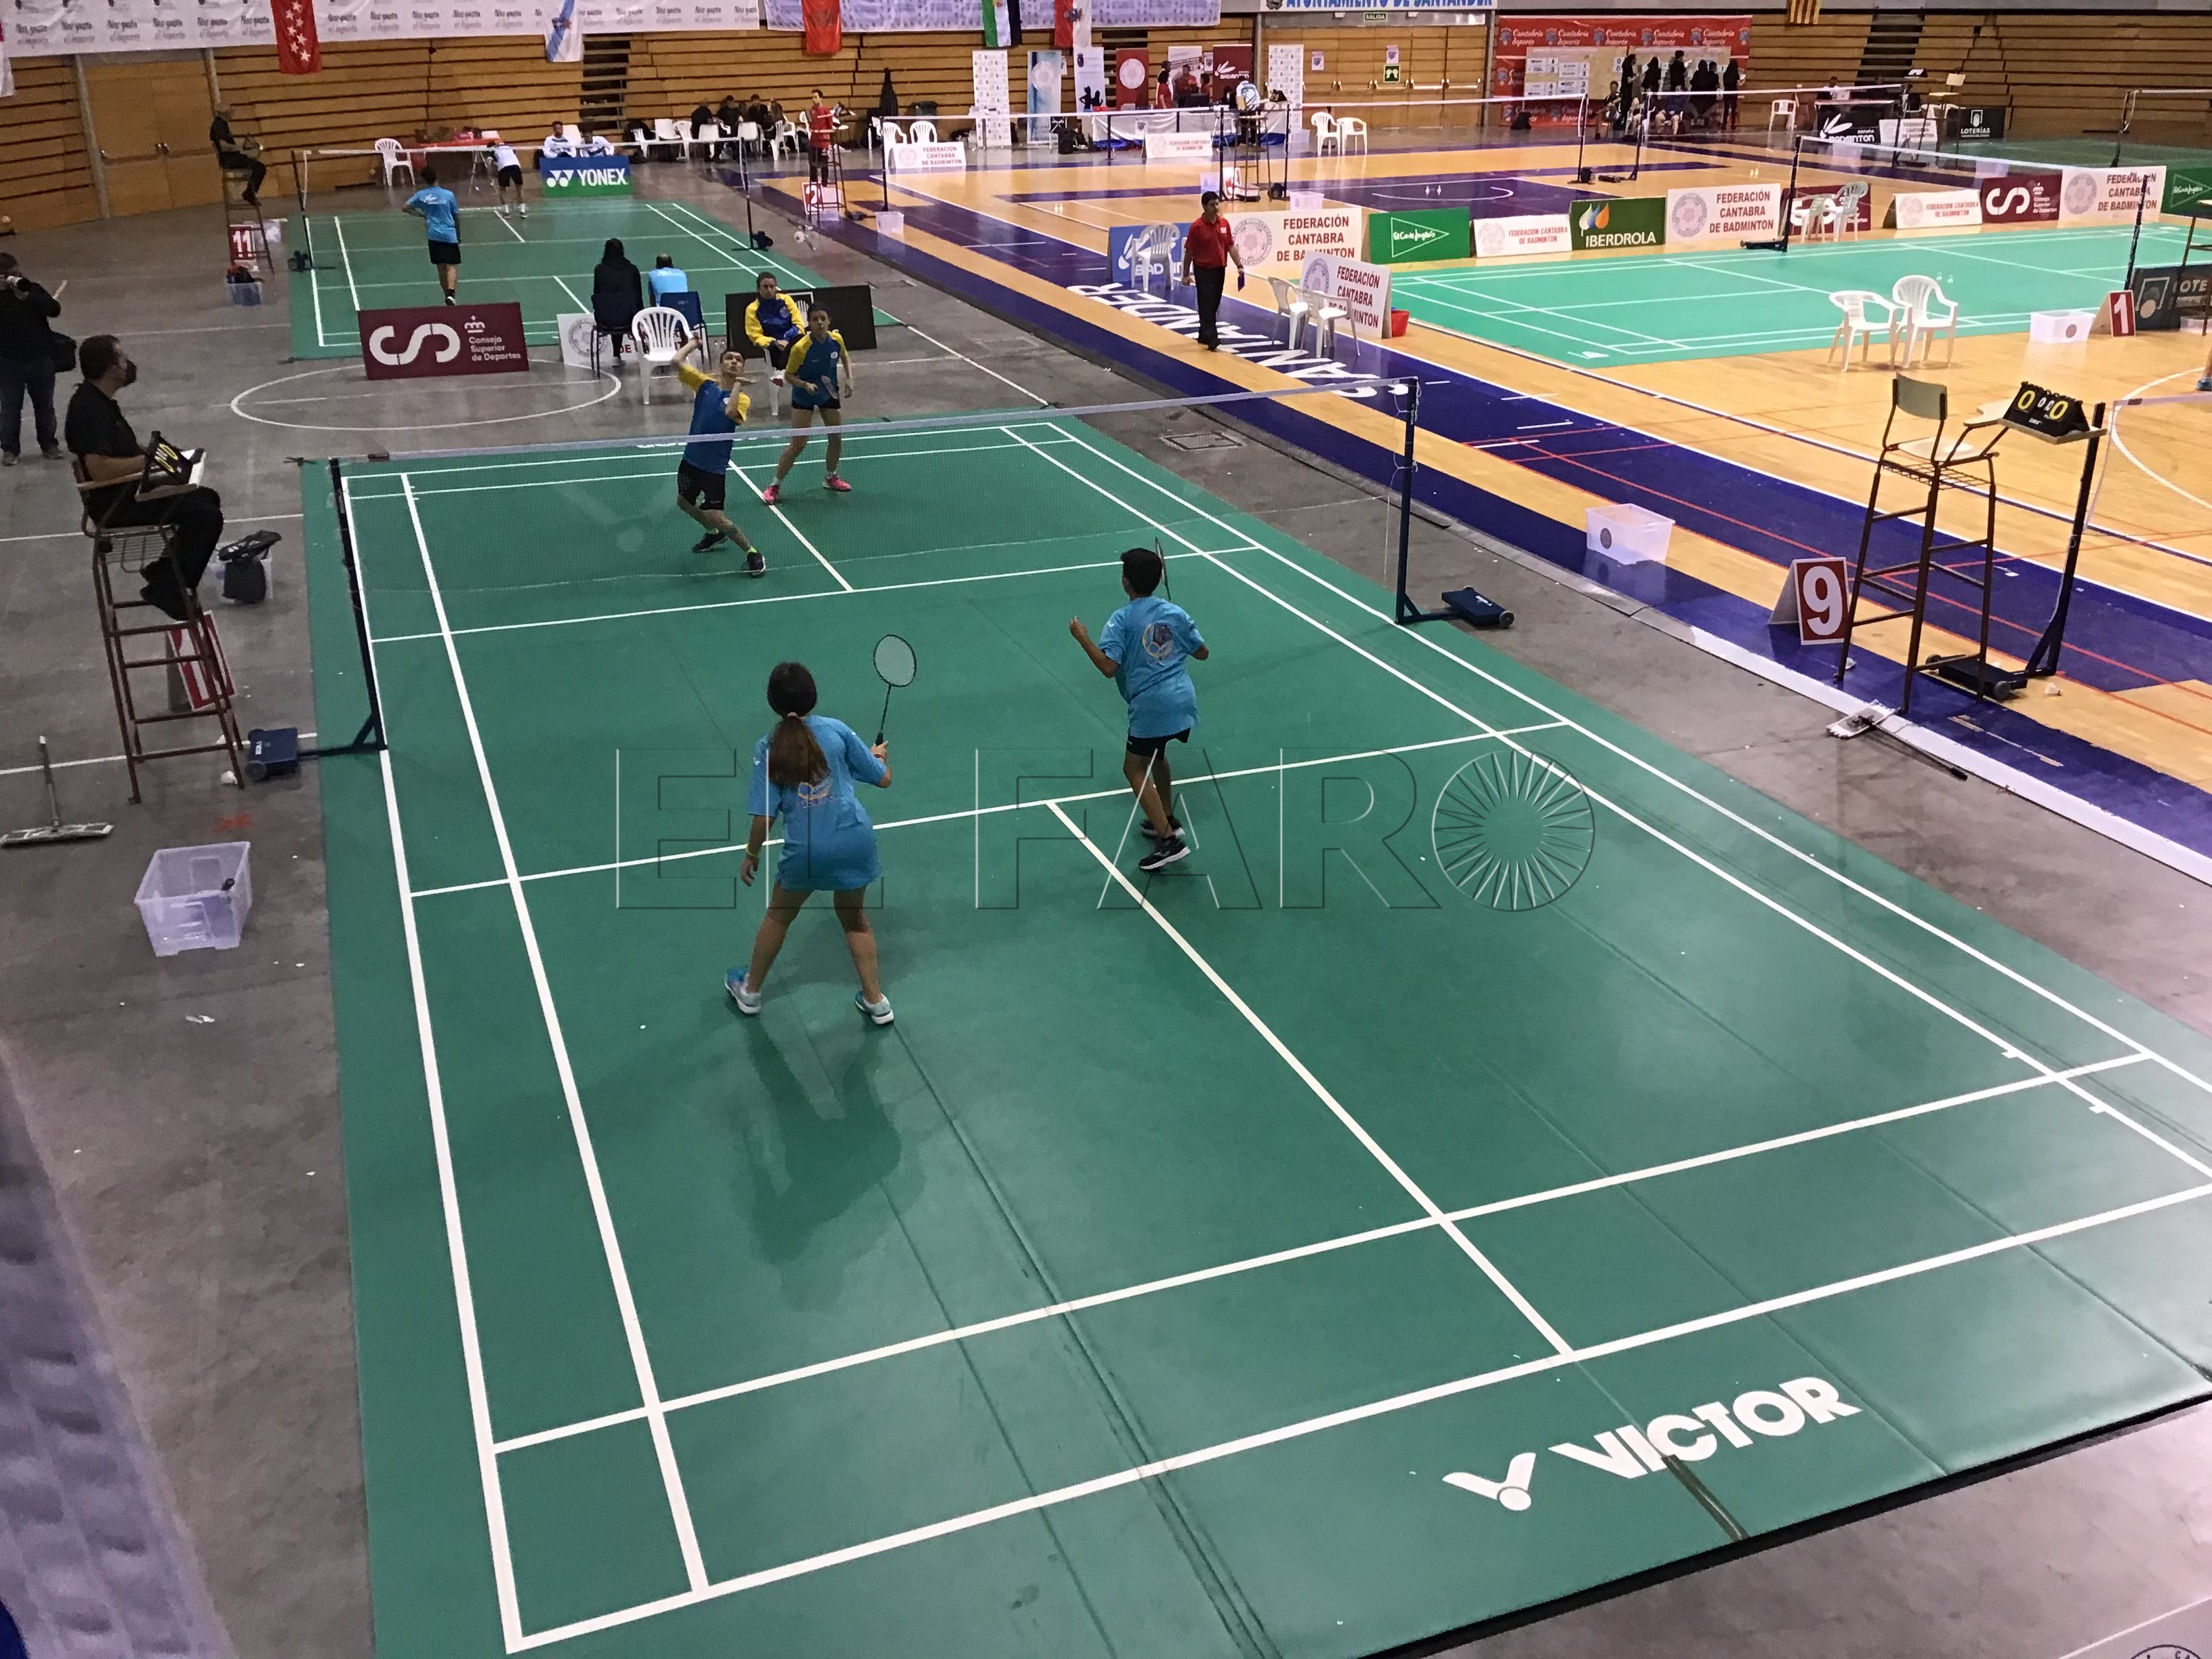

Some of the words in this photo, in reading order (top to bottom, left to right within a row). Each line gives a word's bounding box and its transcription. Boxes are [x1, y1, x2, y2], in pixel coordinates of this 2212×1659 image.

[577, 168, 628, 186] YONEX
[1716, 190, 1770, 204] FEDERACIÓN
[2097, 202, 2109, 211] DE
[1284, 214, 1349, 230] FEDERACIÓN
[1710, 223, 1721, 234] DE
[1723, 220, 1774, 232] BADMINTON
[232, 230, 253, 258] 11
[1288, 230, 1345, 245] CÁNTABRA
[1527, 235, 1557, 243] BADMINTON
[1585, 232, 1656, 248] IBERDROLA
[1277, 251, 1288, 262] DE
[1337, 266, 1380, 289] FEDERACIÓN
[1337, 283, 1373, 307] CÁNTABRA
[2114, 294, 2129, 333] 1
[469, 335, 502, 346] Consejo
[470, 344, 505, 354] Superior
[484, 352, 520, 362] Deportes
[2018, 390, 2035, 410] 0
[2049, 401, 2068, 419] 0
[1803, 566, 1843, 636] 9
[1548, 1377, 1863, 1479] VICTOR
